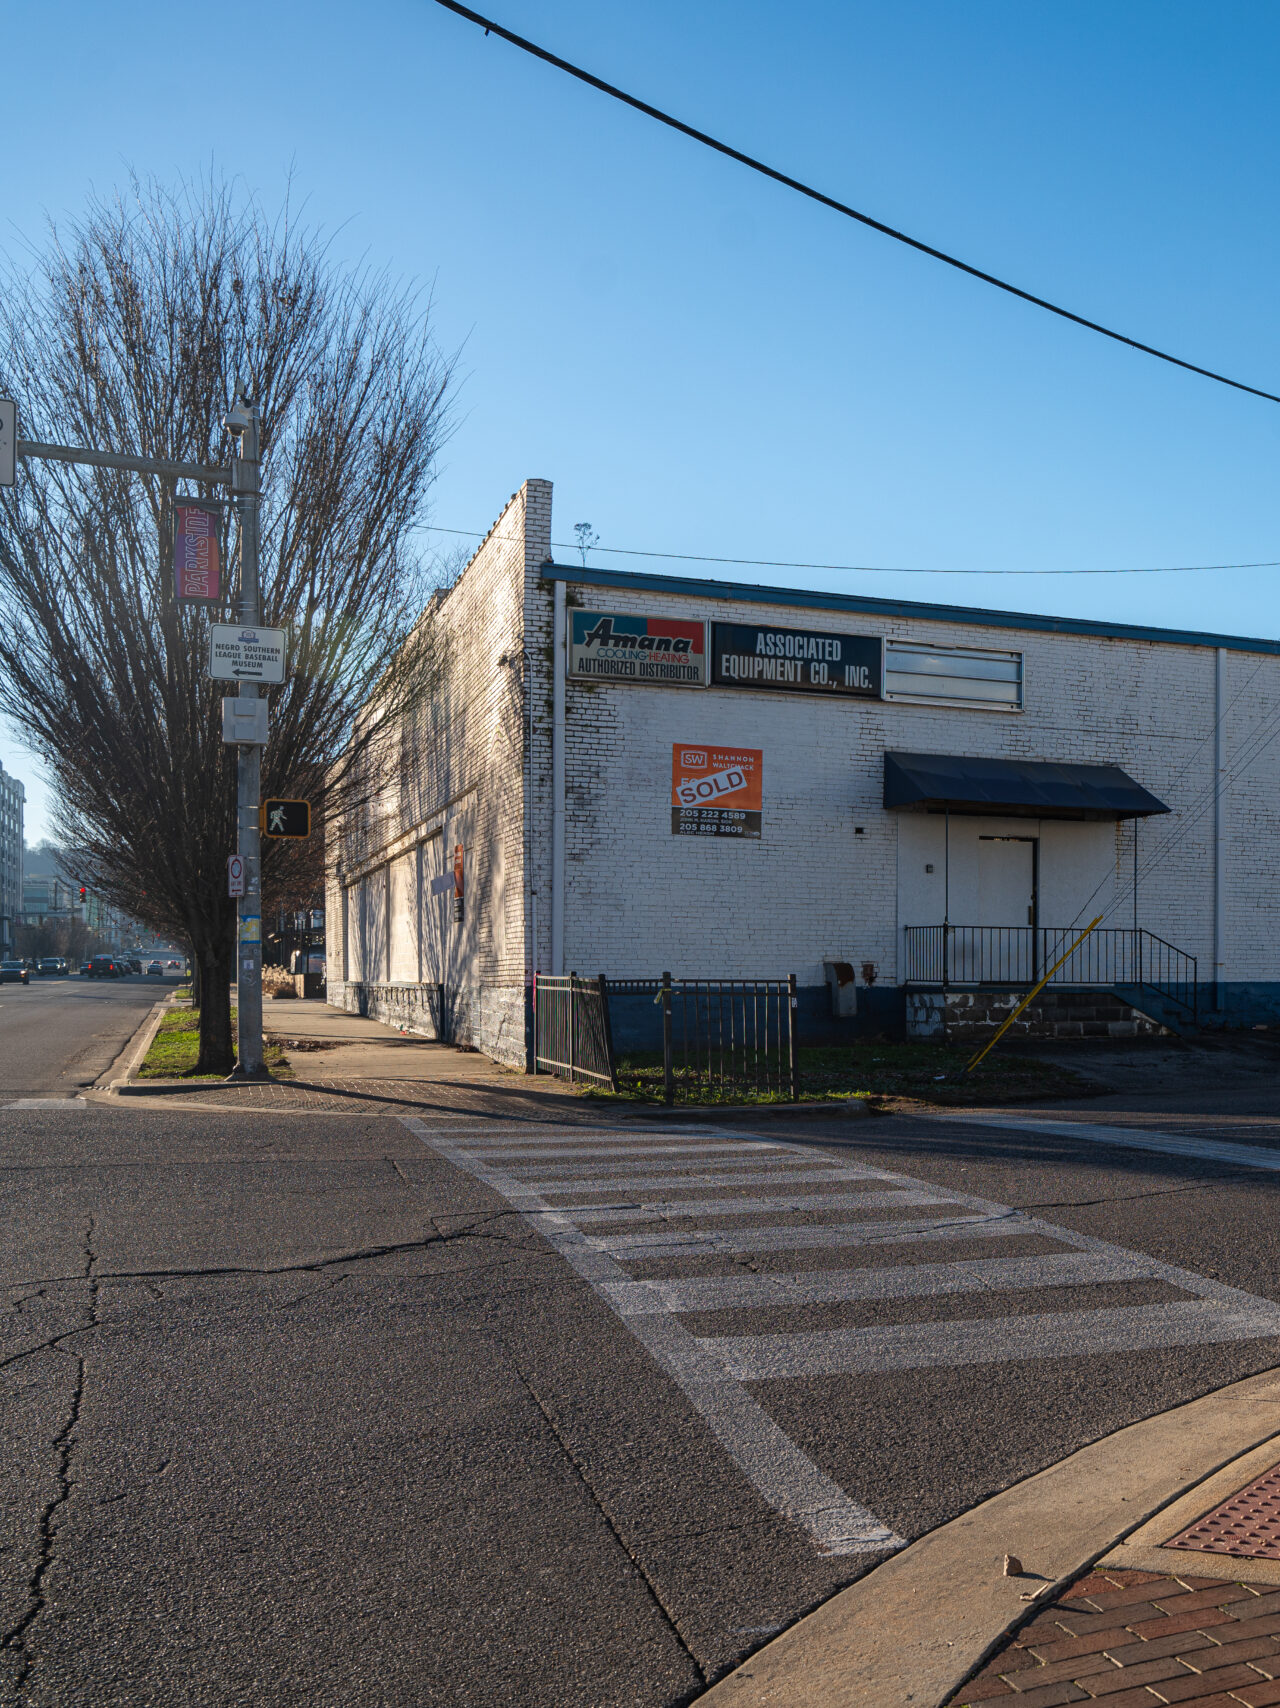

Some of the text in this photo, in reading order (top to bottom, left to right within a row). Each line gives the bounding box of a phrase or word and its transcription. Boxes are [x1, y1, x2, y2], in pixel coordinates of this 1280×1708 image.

[184, 507, 209, 597] PARKSIDE
[584, 618, 691, 653] Amana
[215, 643, 281, 655] NEGRO SOUTHERN
[756, 632, 842, 662] ASSOCIATED
[215, 651, 279, 662] LEAGUE BASEBALL
[231, 660, 263, 669] MUSEUM
[578, 657, 699, 681] AUTHORIZED DISTRIBUTOR
[721, 654, 873, 689] EQUIPMENT CO., INC.
[685, 754, 704, 765] SW
[712, 754, 754, 762] SHANNON
[680, 771, 743, 804] SOLD
[680, 809, 746, 820] 205 222 4589
[680, 823, 698, 831] 205
[719, 825, 743, 833] 3809
